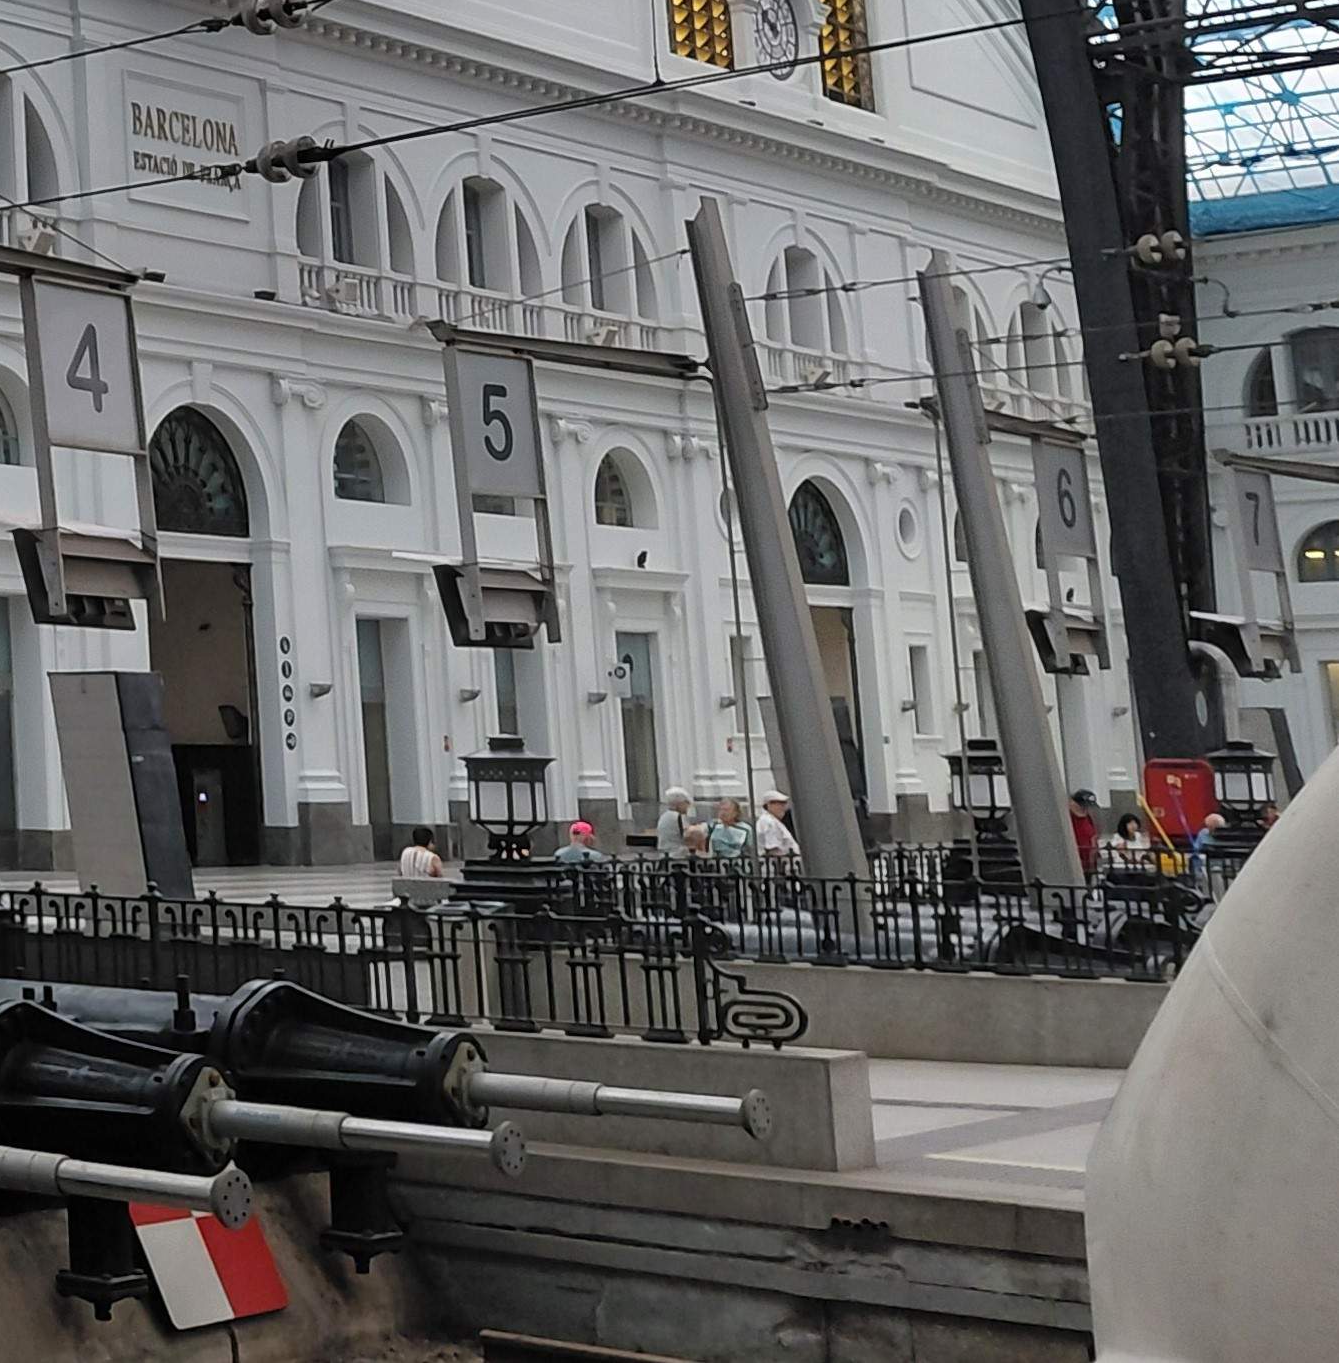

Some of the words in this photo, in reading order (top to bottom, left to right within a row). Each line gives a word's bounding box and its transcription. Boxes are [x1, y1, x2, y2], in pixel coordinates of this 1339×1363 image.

[131, 101, 239, 156] BARCELONA
[133, 151, 178, 176] ESTACIÓ
[66, 323, 109, 413] 4
[483, 384, 513, 461] 5
[1057, 468, 1076, 529] 6
[1245, 492, 1260, 546] 7
